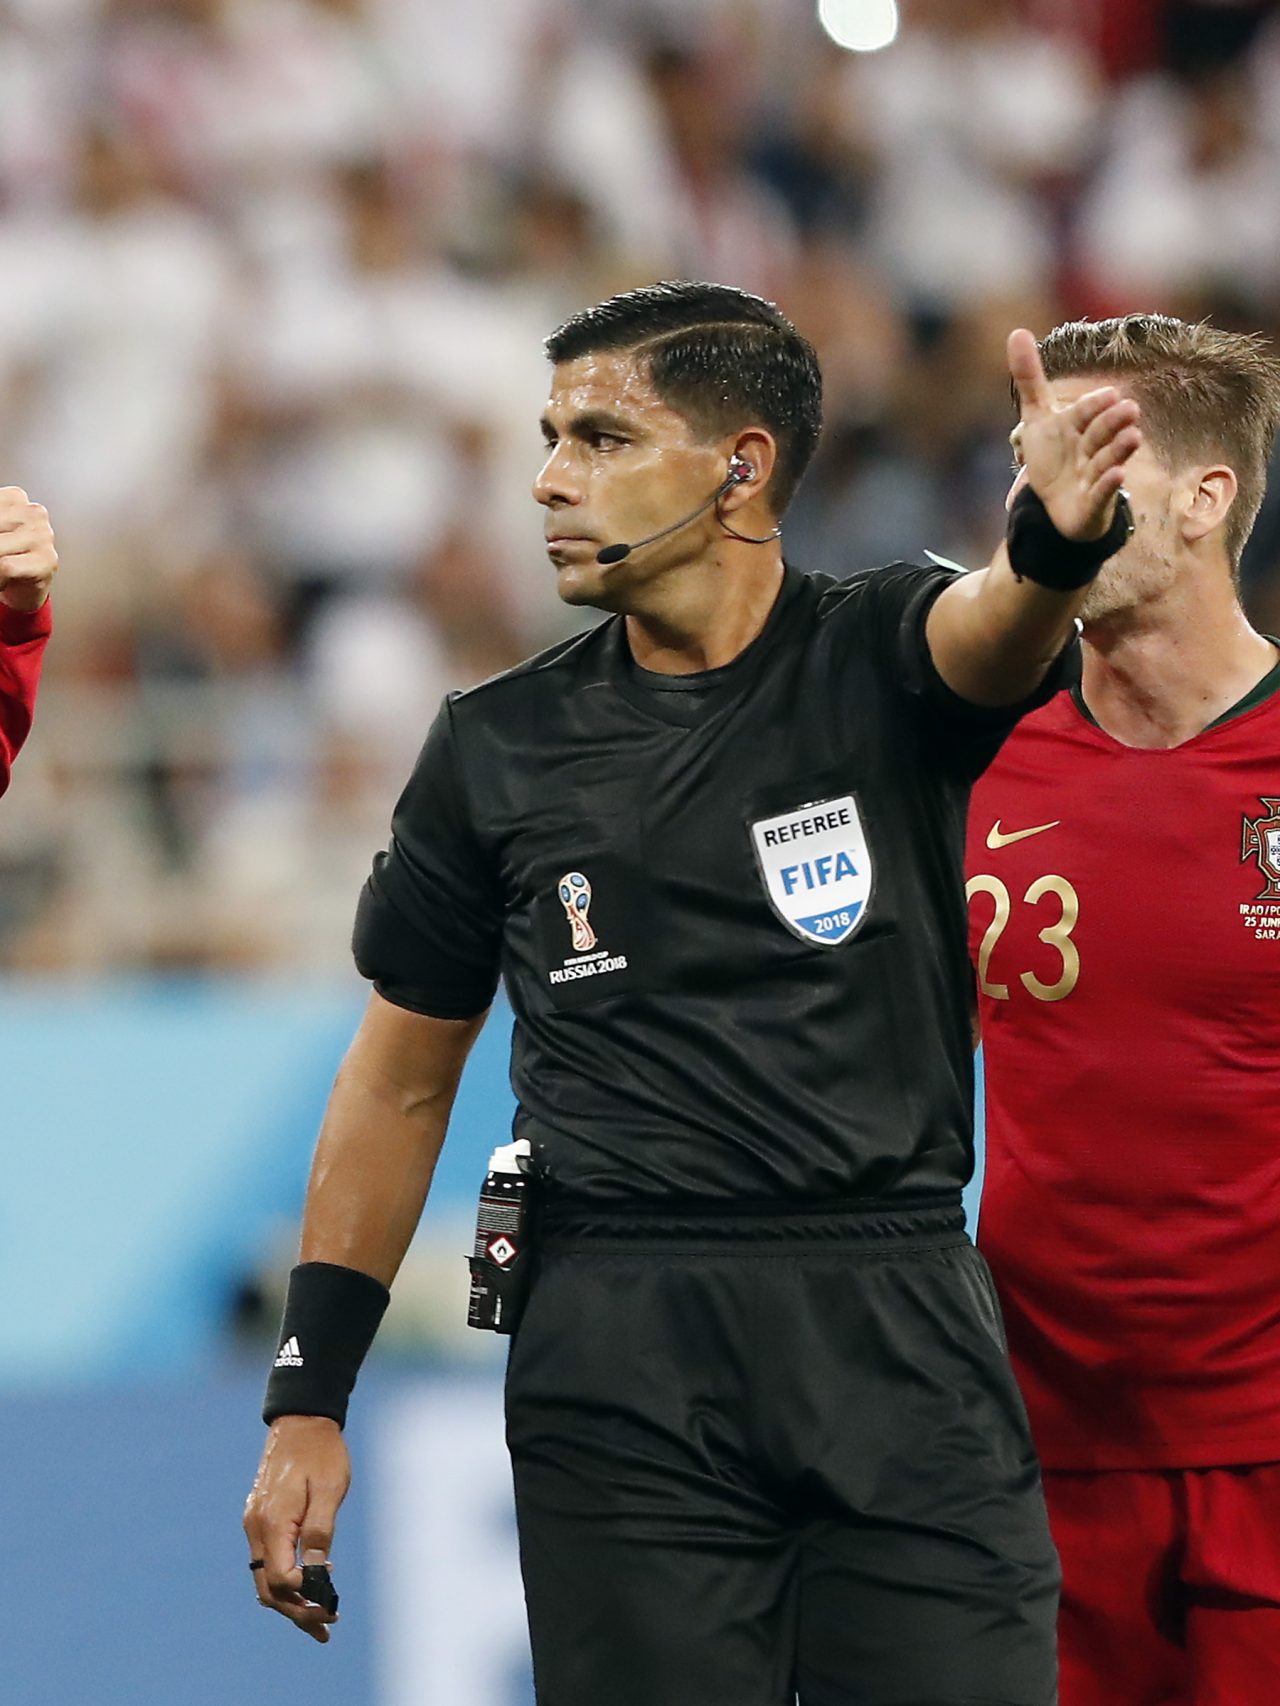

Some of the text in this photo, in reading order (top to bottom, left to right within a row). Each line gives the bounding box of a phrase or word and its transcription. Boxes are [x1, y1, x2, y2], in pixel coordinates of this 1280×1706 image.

[763, 808, 851, 847] REFEREE
[779, 851, 859, 896] FIFA
[813, 911, 851, 934] 2018
[965, 874, 1080, 1001] 23
[1244, 916, 1257, 927] 25
[549, 955, 628, 984] RUSSIA 2018
